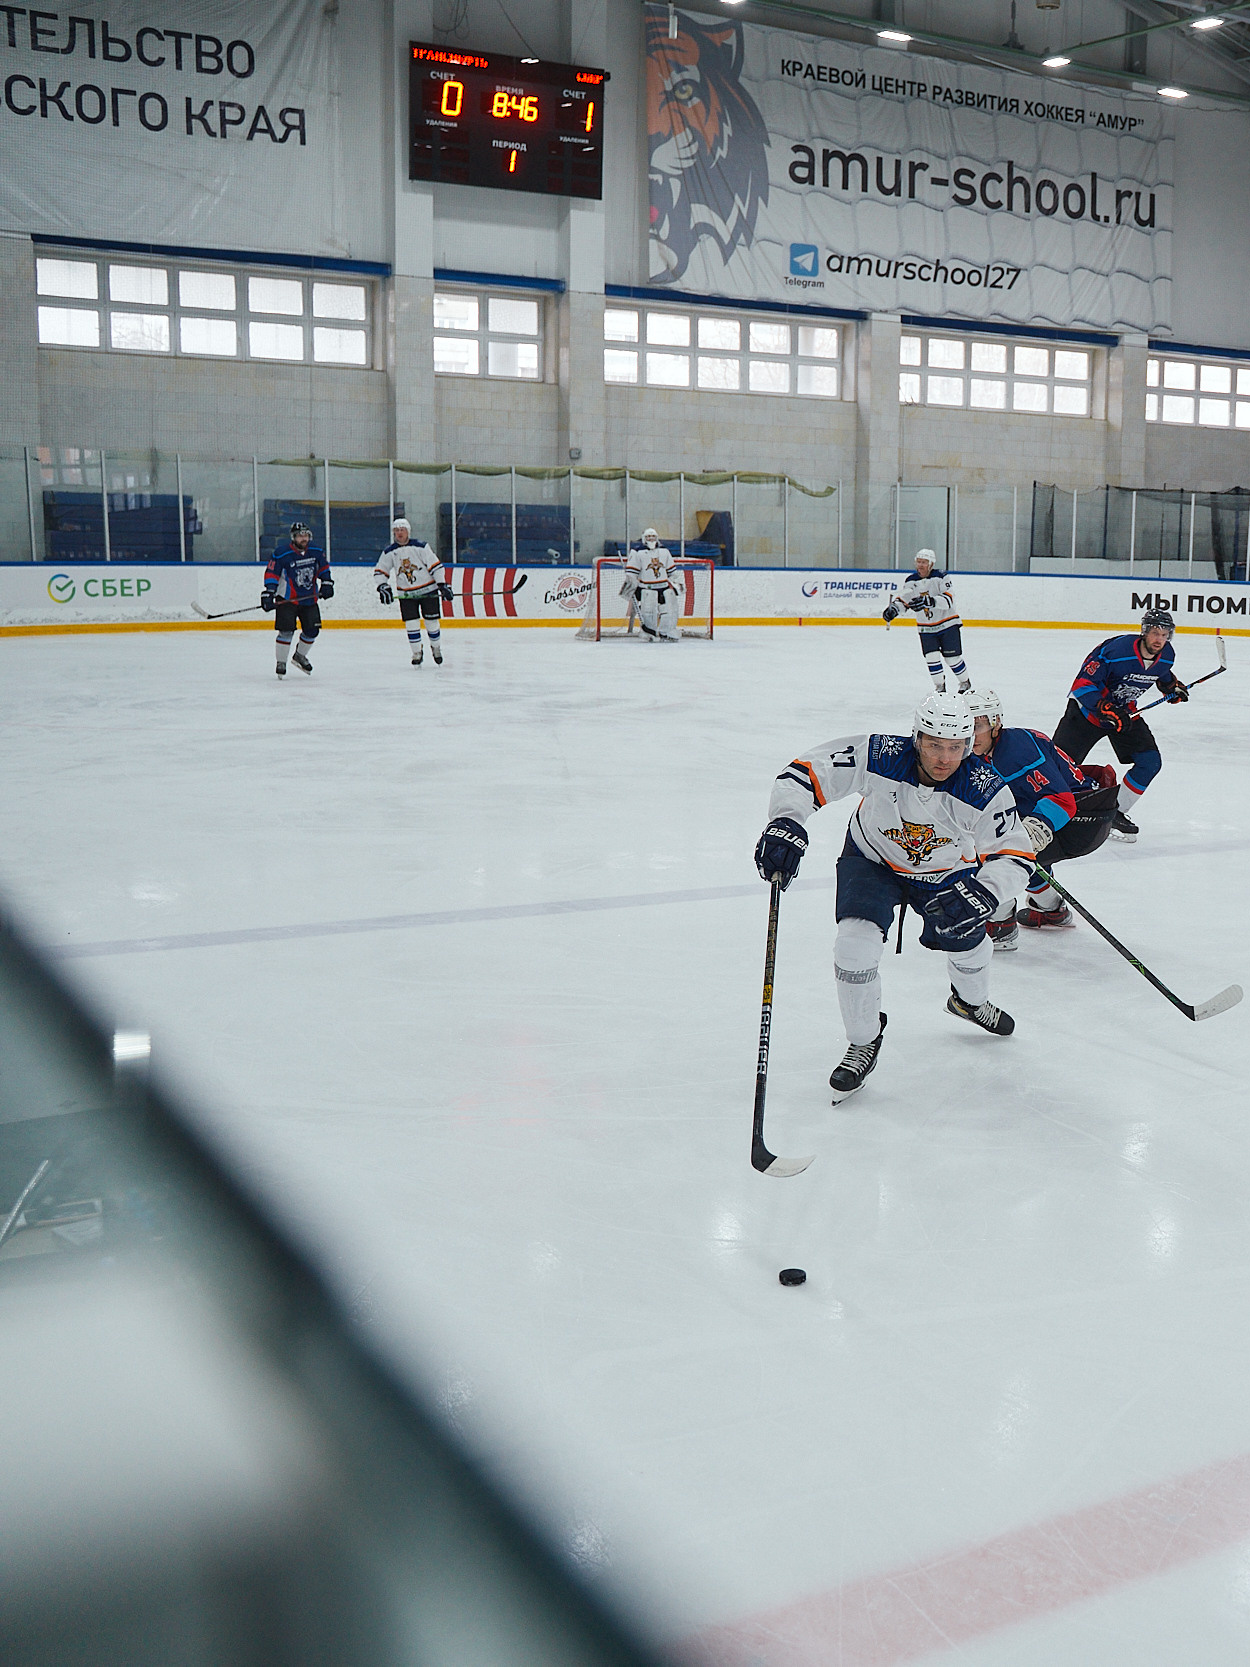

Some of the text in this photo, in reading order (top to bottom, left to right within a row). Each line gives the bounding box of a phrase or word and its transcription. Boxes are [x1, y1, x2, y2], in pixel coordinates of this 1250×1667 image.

[0, 5, 255, 79] ТЕЛЬСТВО
[430, 70, 455, 81] СЧЕТ
[441, 80, 464, 117] 0
[495, 84, 524, 96] ВРЕМЯ
[562, 89, 587, 100] СЧЕТ
[780, 59, 866, 89] КРАЕВОЙ
[871, 75, 927, 98] ЦЕНТР
[932, 85, 1019, 114] РАЗВИТИЯ
[1023, 100, 1085, 124] ХОККЕЯ
[4, 74, 306, 146] СКОГО КРАЯ
[492, 92, 539, 122] 8:46
[585, 101, 595, 132] 1
[425, 118, 458, 128] УДАЛЕНИЯ
[492, 139, 528, 151] ПЕРИОД
[559, 135, 589, 145] УДАЛЕНИЯ
[509, 150, 517, 173] 1
[788, 144, 1156, 228] amur-school.ru
[784, 276, 825, 288] Telegram
[825, 253, 1021, 290] amurschool27
[83, 578, 151, 598] СБЕР
[823, 581, 898, 591] ТРАНСНЕФТЬ
[1131, 592, 1178, 611] МЫ
[830, 745, 856, 768] 27
[1026, 770, 1050, 793] 14
[993, 806, 1017, 839] 27
